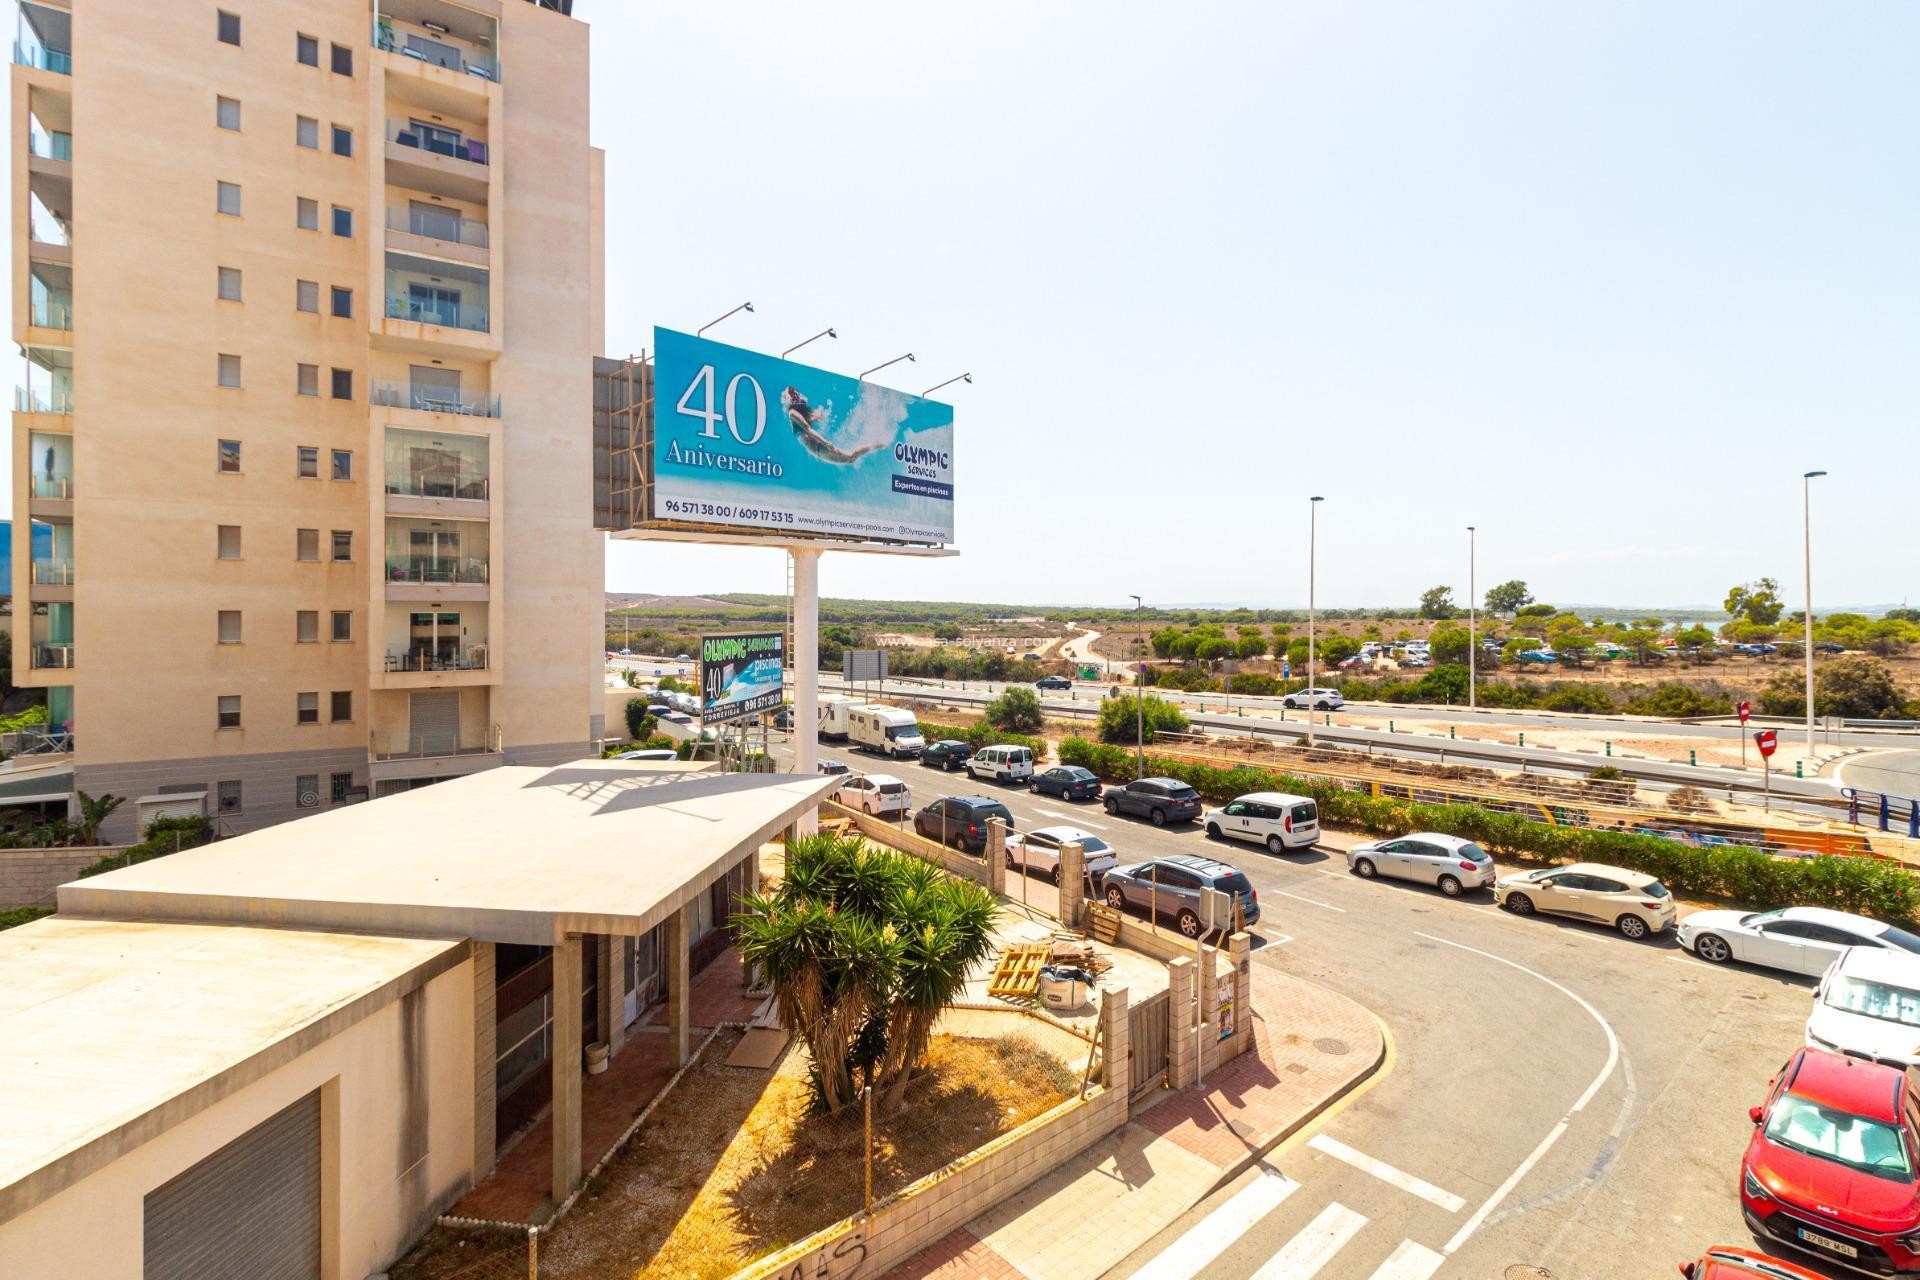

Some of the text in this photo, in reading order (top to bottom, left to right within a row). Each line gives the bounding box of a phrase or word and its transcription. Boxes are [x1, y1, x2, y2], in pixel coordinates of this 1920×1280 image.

[676, 364, 767, 445] 40
[665, 439, 783, 477] Aniversario
[895, 443, 949, 470] OLYMPIC
[907, 465, 937, 479] SERVICES
[894, 480, 920, 491] Expertos
[927, 486, 949, 496] piscinas
[665, 500, 680, 512] 96
[681, 502, 699, 514] 571
[701, 504, 714, 515] 38
[716, 505, 731, 517] 00
[732, 507, 738, 518] /
[739, 508, 758, 520] 609
[760, 510, 770, 521] 17
[771, 511, 782, 522] 53
[784, 512, 794, 523] 15
[704, 638, 747, 662] OLYMPIC
[754, 653, 782, 676] piscinas
[706, 667, 721, 698] 40
[704, 707, 740, 723] TORREVIEJA
[1805, 1232, 1830, 1247] 3789
